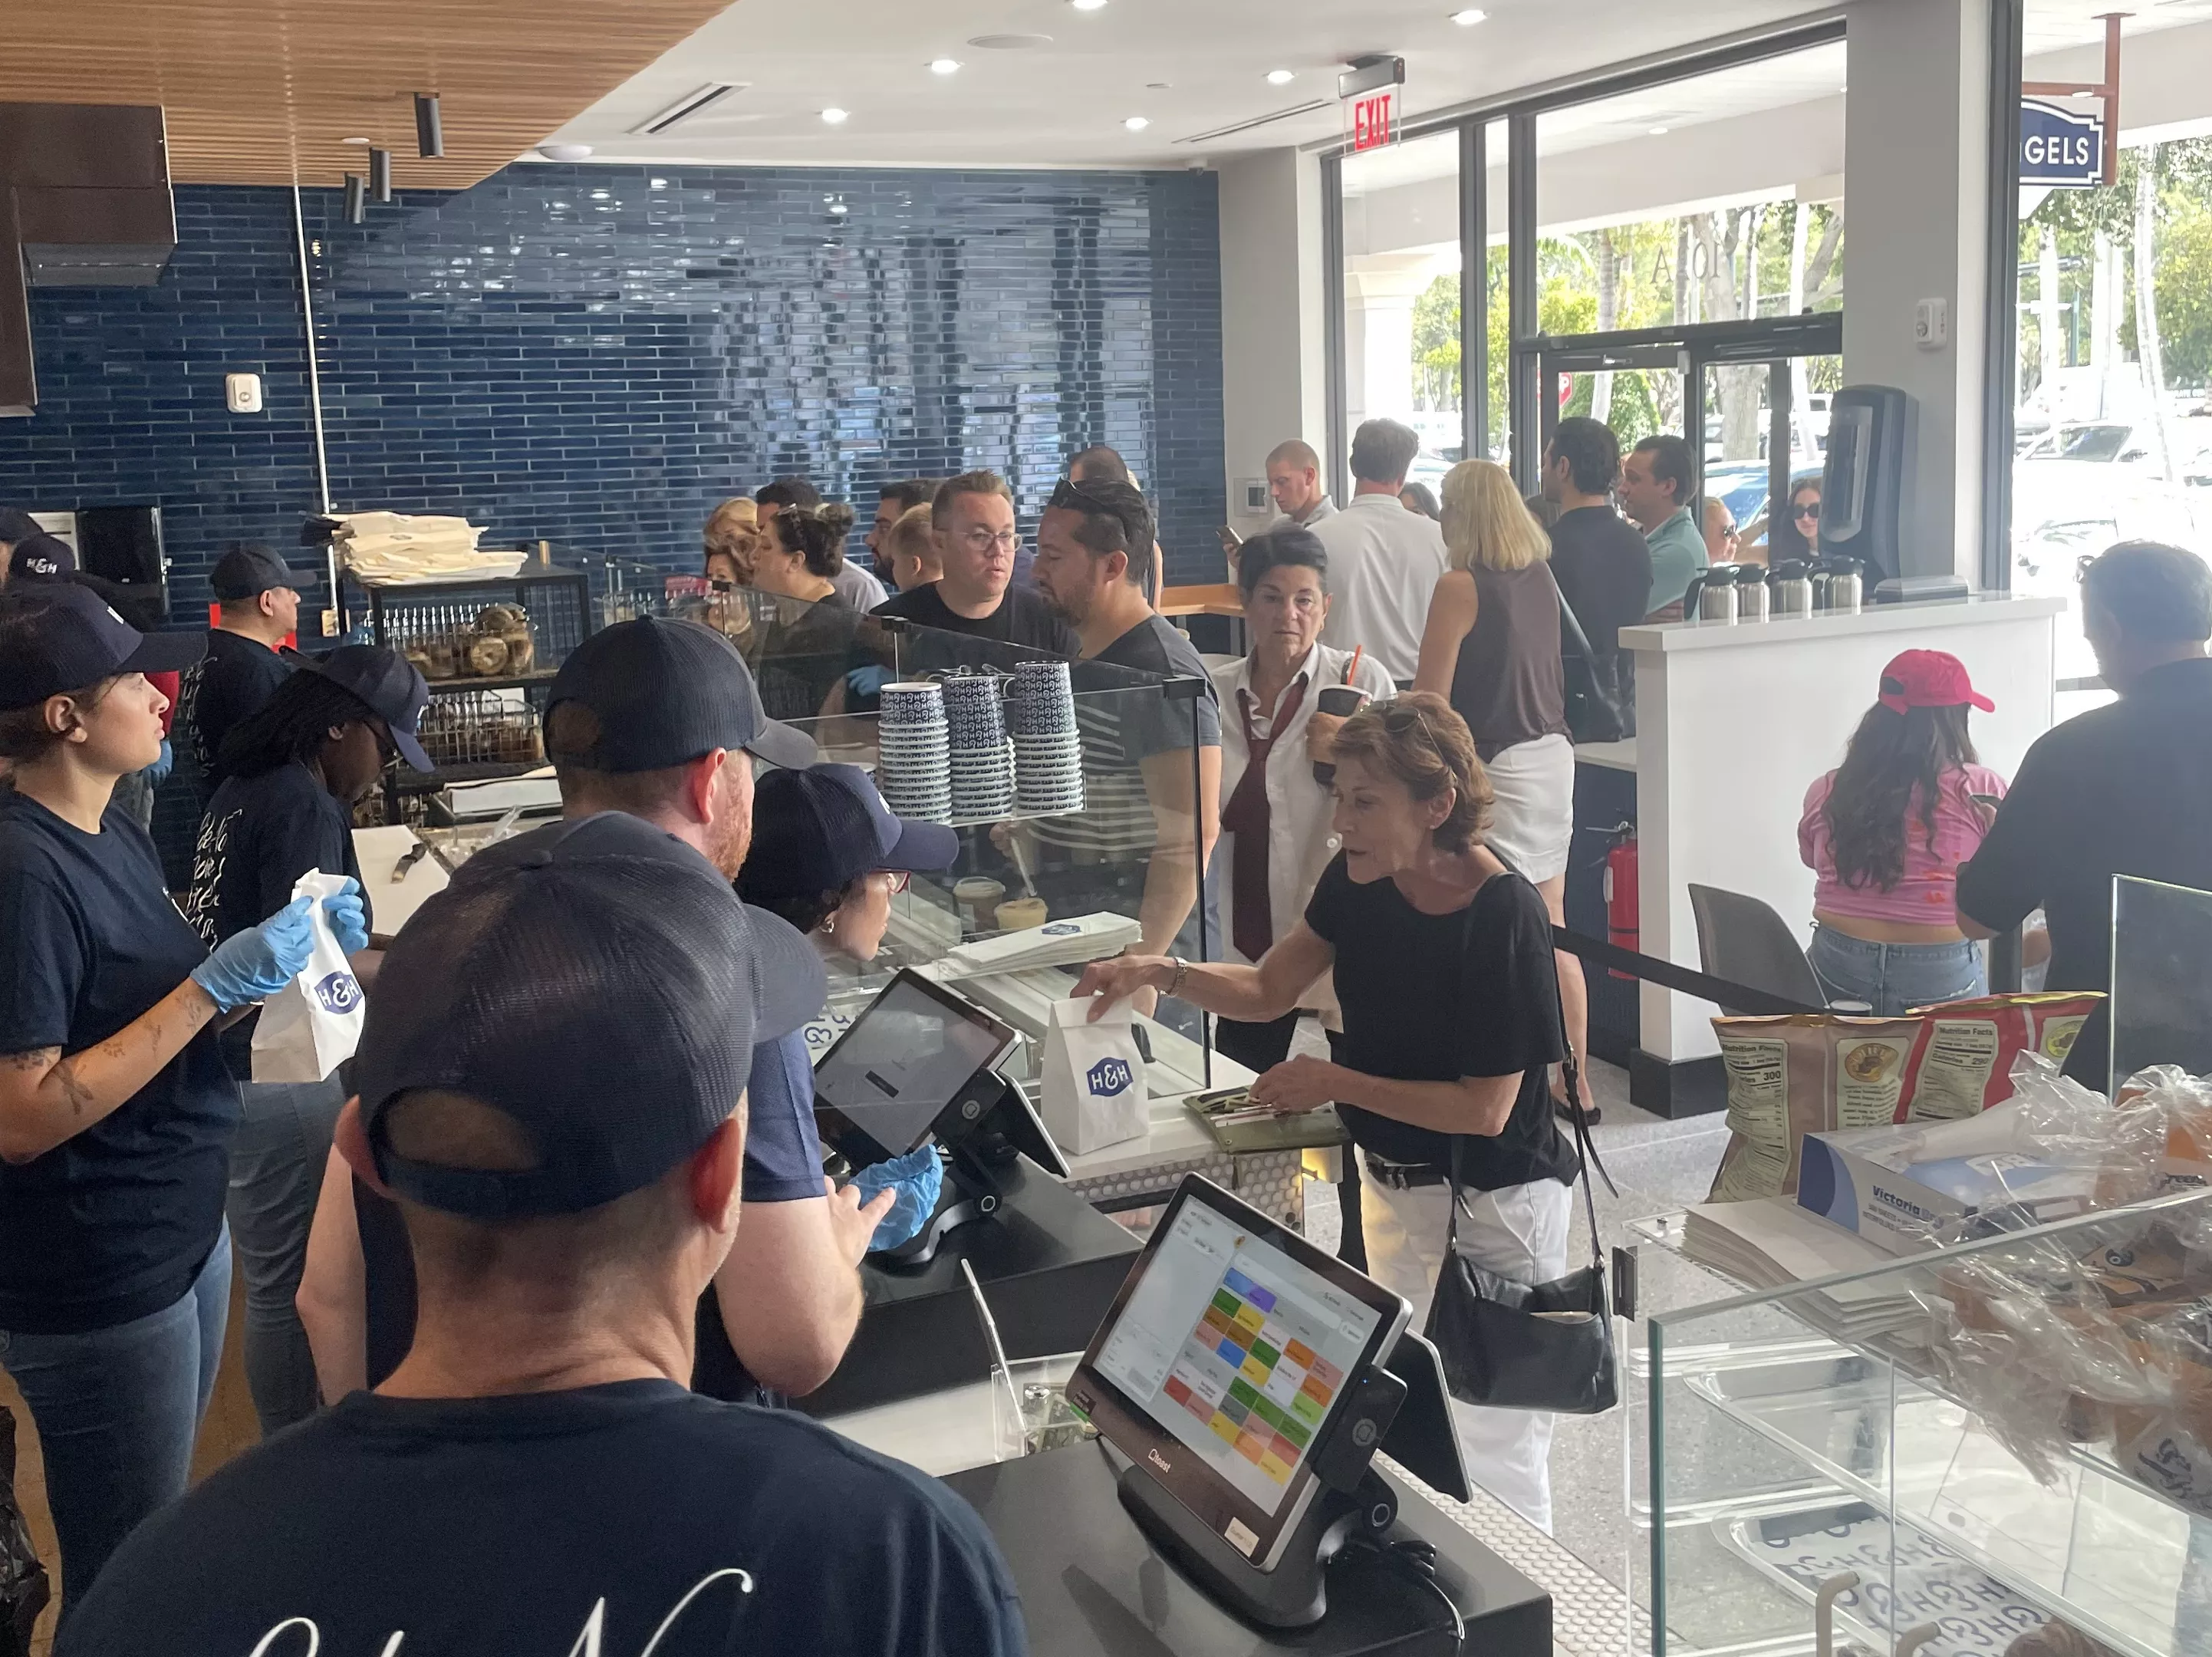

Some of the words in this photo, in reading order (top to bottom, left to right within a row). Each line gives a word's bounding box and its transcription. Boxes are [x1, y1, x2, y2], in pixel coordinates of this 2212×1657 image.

[1355, 94, 1391, 151] EXIT
[2019, 136, 2089, 166] GELS
[26, 558, 58, 574] H&H
[318, 978, 359, 1007] H&H
[1091, 1064, 1129, 1089] H&H
[1763, 1070, 1781, 1081] 300
